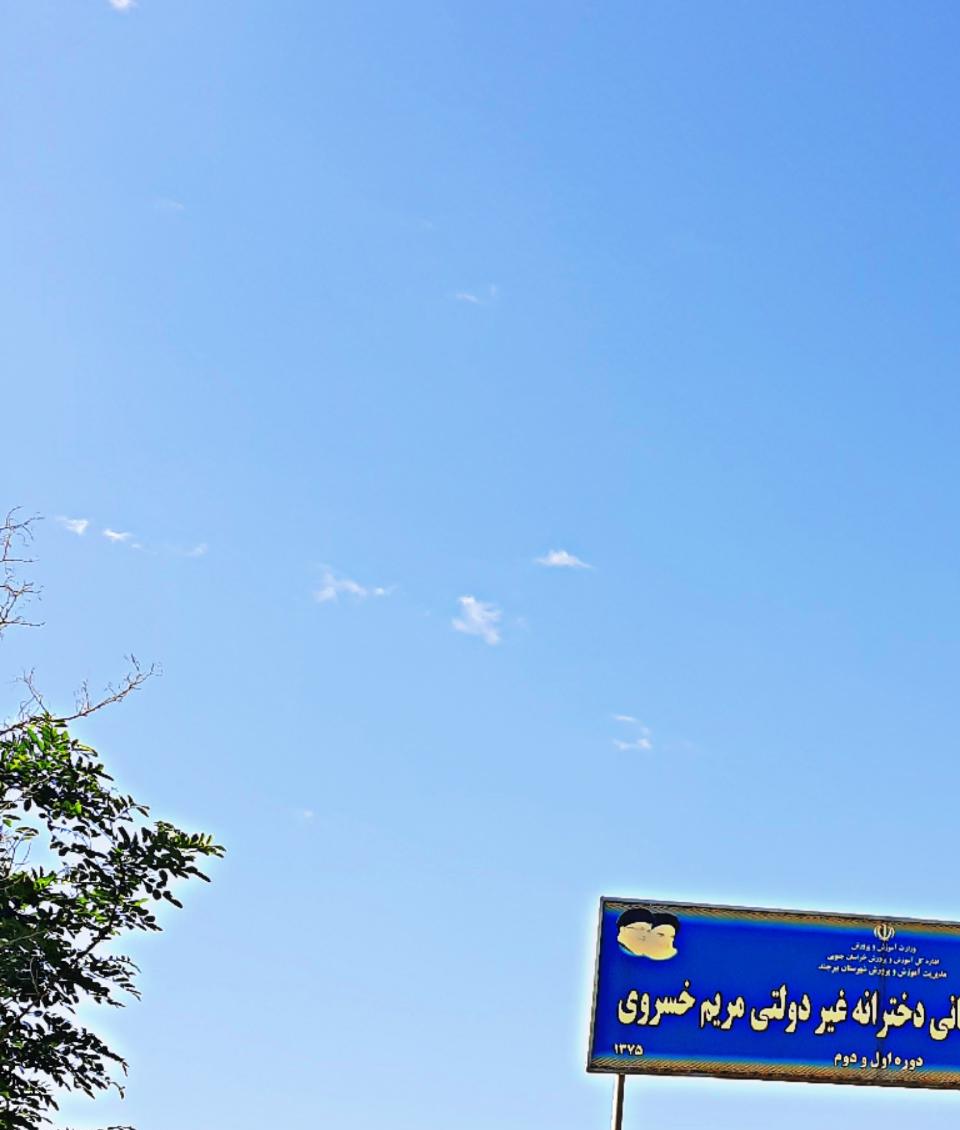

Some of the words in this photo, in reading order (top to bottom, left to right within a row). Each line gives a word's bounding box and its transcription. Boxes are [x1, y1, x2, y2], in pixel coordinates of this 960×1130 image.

[618, 979, 696, 1026] خسروی
[700, 992, 745, 1029] مریم
[750, 984, 811, 1033] دولتی
[814, 989, 848, 1035] غیر
[613, 1043, 644, 1056] ۱۳۷۵
[834, 1051, 857, 1069] دوم
[860, 1056, 867, 1068] و
[870, 1051, 893, 1069] اول
[895, 1056, 924, 1071] دوره
